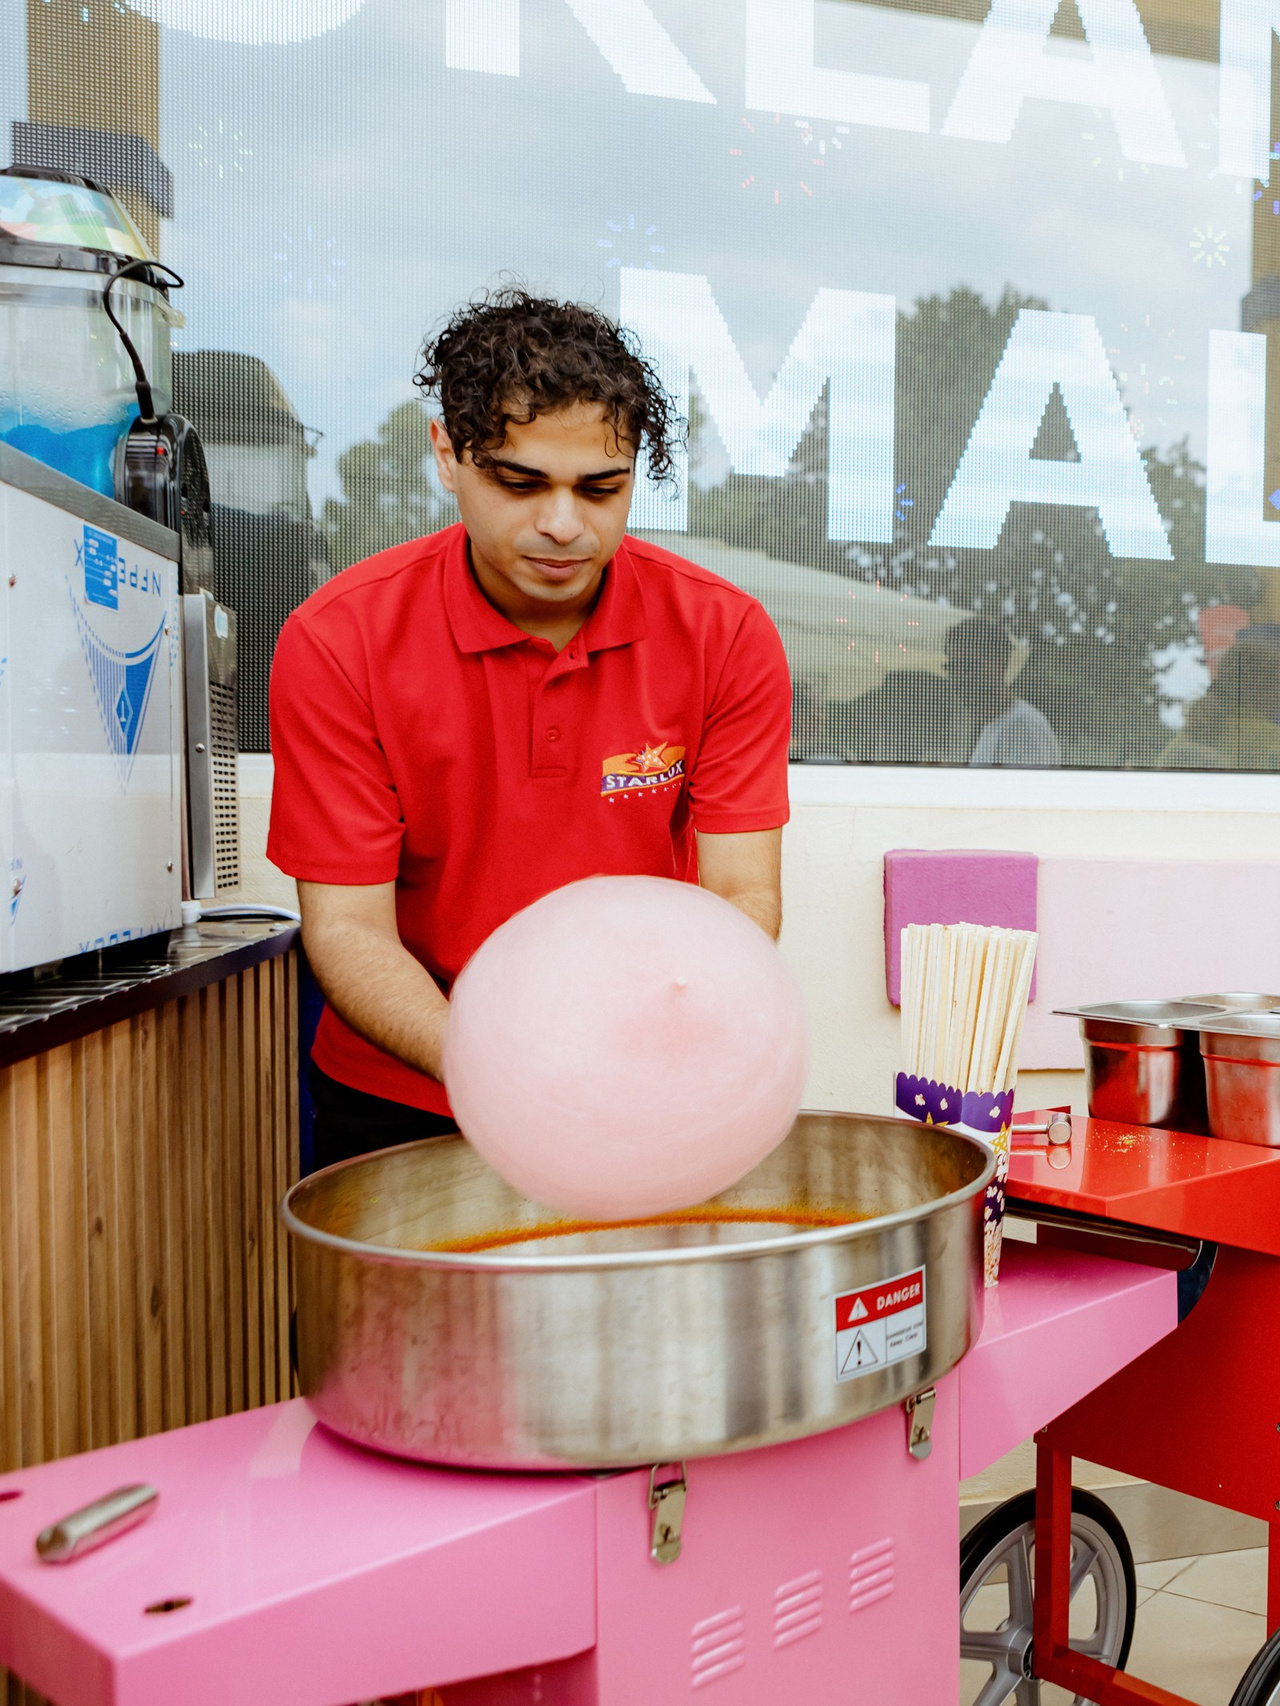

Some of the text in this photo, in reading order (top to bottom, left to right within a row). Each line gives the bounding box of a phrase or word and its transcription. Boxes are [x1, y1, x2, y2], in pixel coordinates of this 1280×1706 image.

[73, 538, 163, 598] NFPEX
[605, 760, 683, 789] STARLUX
[876, 1282, 920, 1311] DANGER
